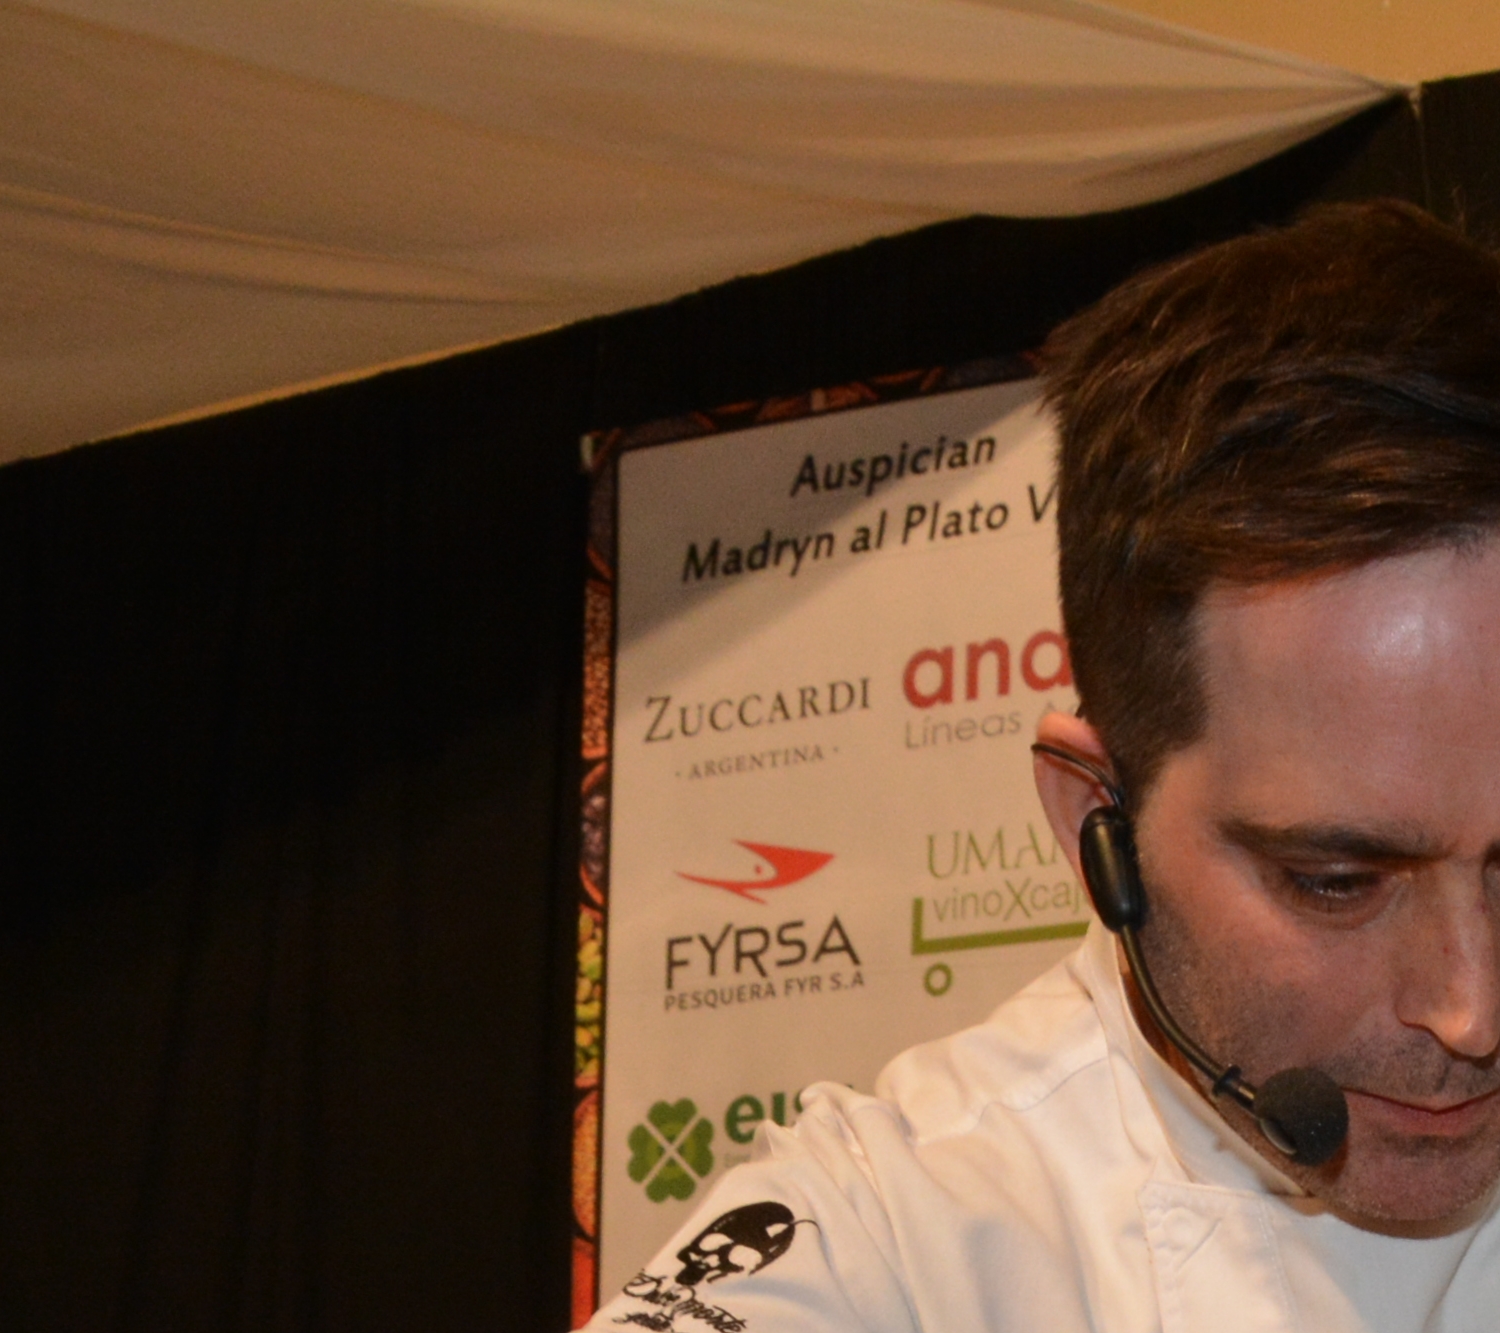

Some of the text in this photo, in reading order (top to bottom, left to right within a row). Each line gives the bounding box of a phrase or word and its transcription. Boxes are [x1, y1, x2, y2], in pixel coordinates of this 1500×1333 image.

[790, 434, 996, 497] Auspician
[682, 528, 835, 583] Madryn
[850, 511, 886, 553] al
[902, 499, 1008, 545] Plato
[904, 710, 1022, 749] Líneas
[688, 744, 825, 780] ARGENTINA
[932, 876, 1086, 923] vinoXcaj
[665, 914, 862, 991] FYRSA
[663, 981, 777, 1012] PESQUERA
[784, 975, 822, 997] FYR
